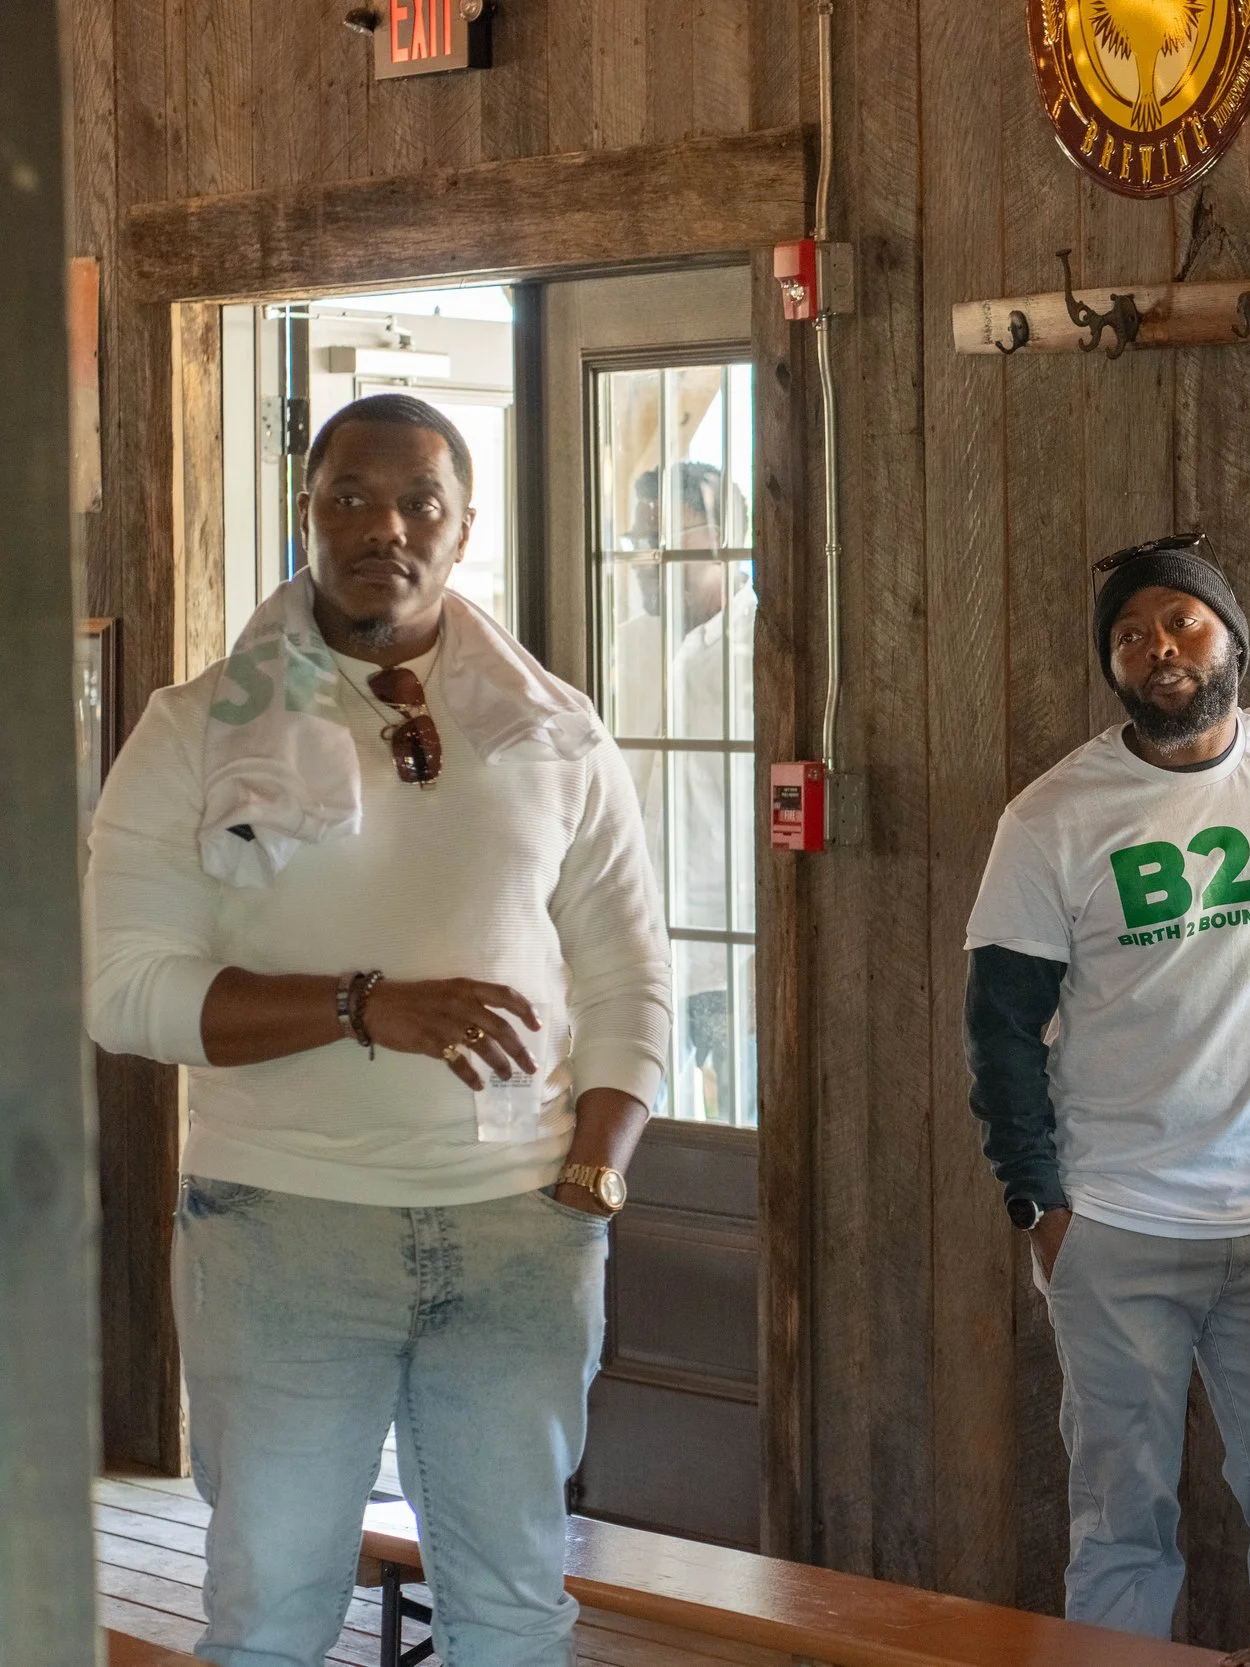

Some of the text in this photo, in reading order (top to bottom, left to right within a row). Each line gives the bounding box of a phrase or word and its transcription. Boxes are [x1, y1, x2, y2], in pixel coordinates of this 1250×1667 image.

[1079, 110, 1210, 185] BREWING
[1117, 923, 1181, 946] BIRTH
[1186, 921, 1196, 938] 2
